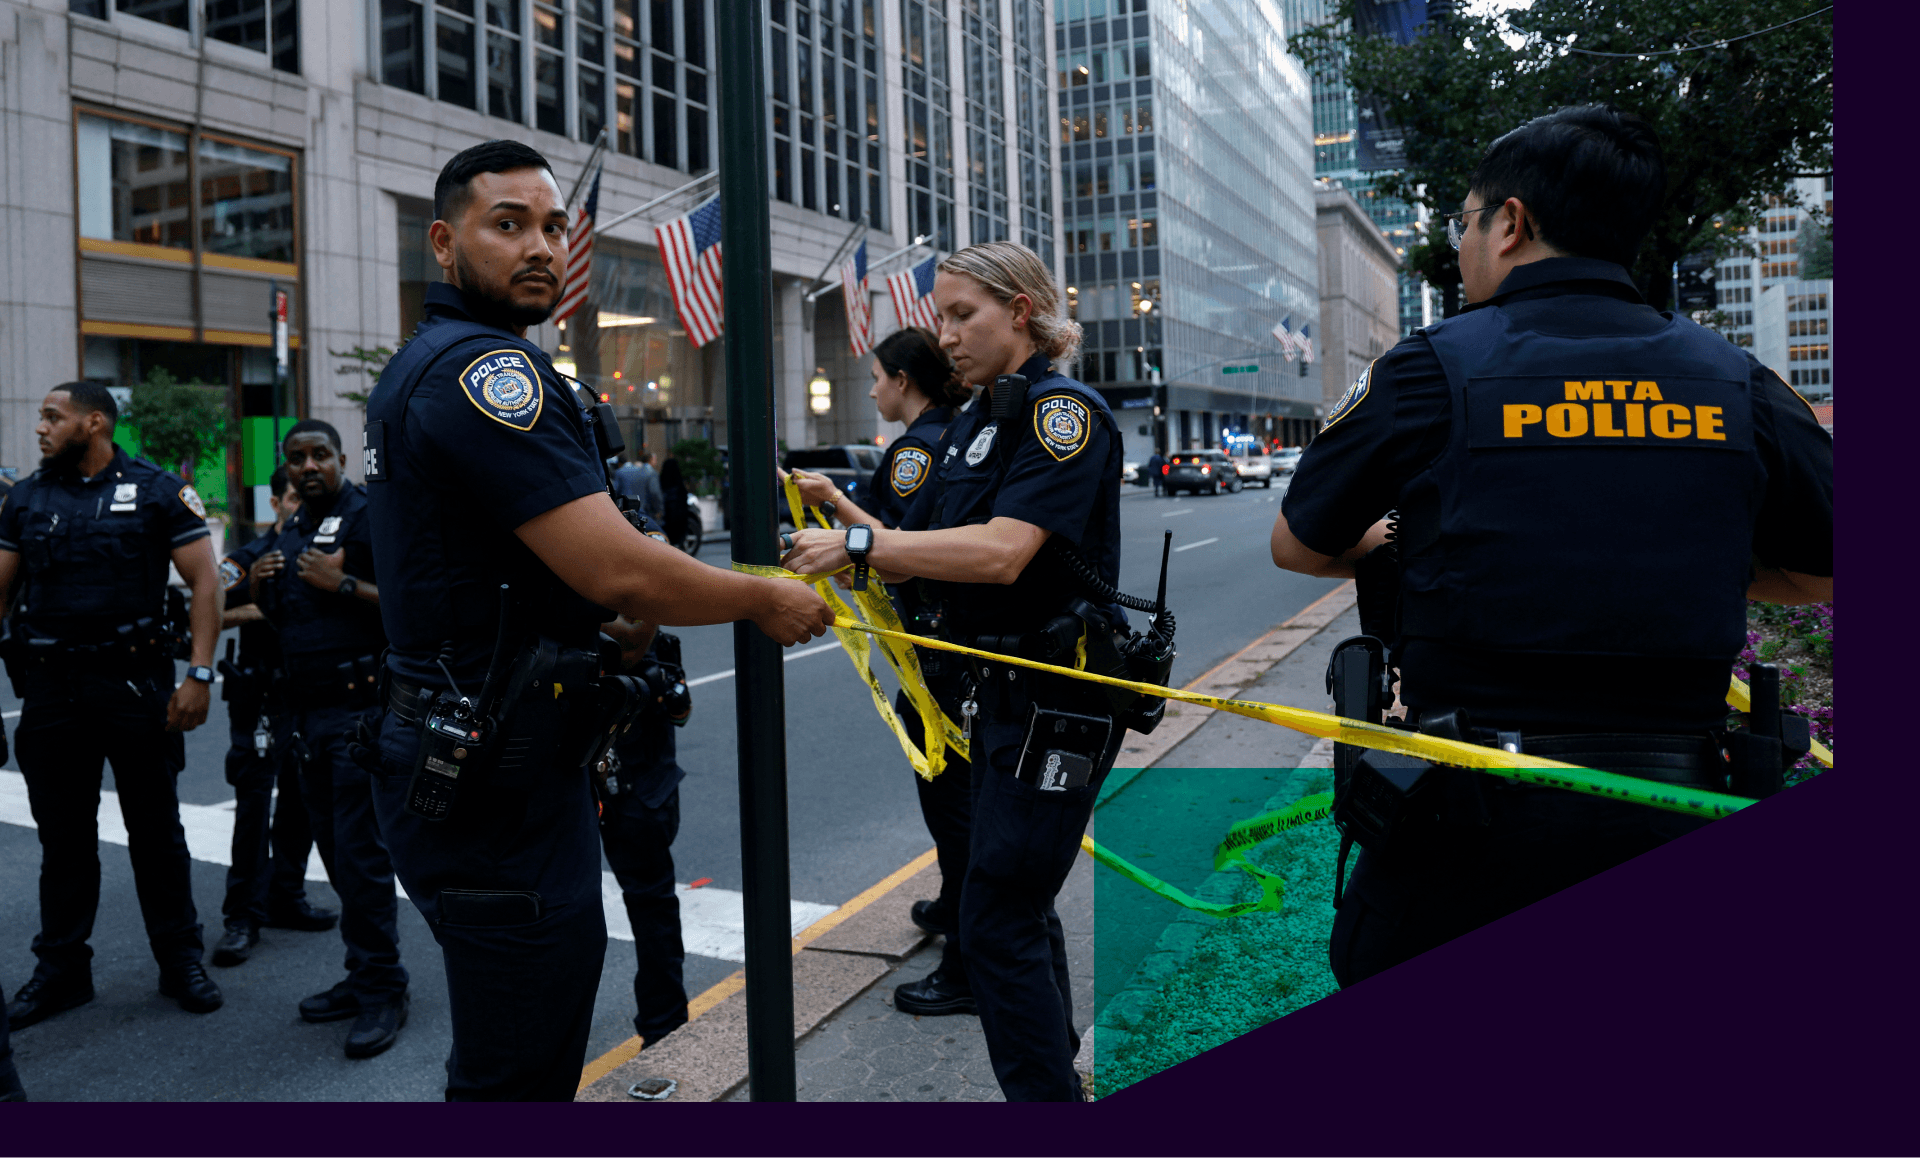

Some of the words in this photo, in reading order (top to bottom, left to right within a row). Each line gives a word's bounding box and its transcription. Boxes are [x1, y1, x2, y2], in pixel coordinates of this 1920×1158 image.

[470, 356, 525, 388] POLICE
[1564, 380, 1664, 401] MTA
[497, 410, 512, 419] NEW
[513, 408, 529, 419] YORK
[527, 397, 540, 412] STATE
[1041, 399, 1085, 422] POLICE
[1502, 402, 1727, 441] POLICE
[895, 450, 928, 466] POLICE
